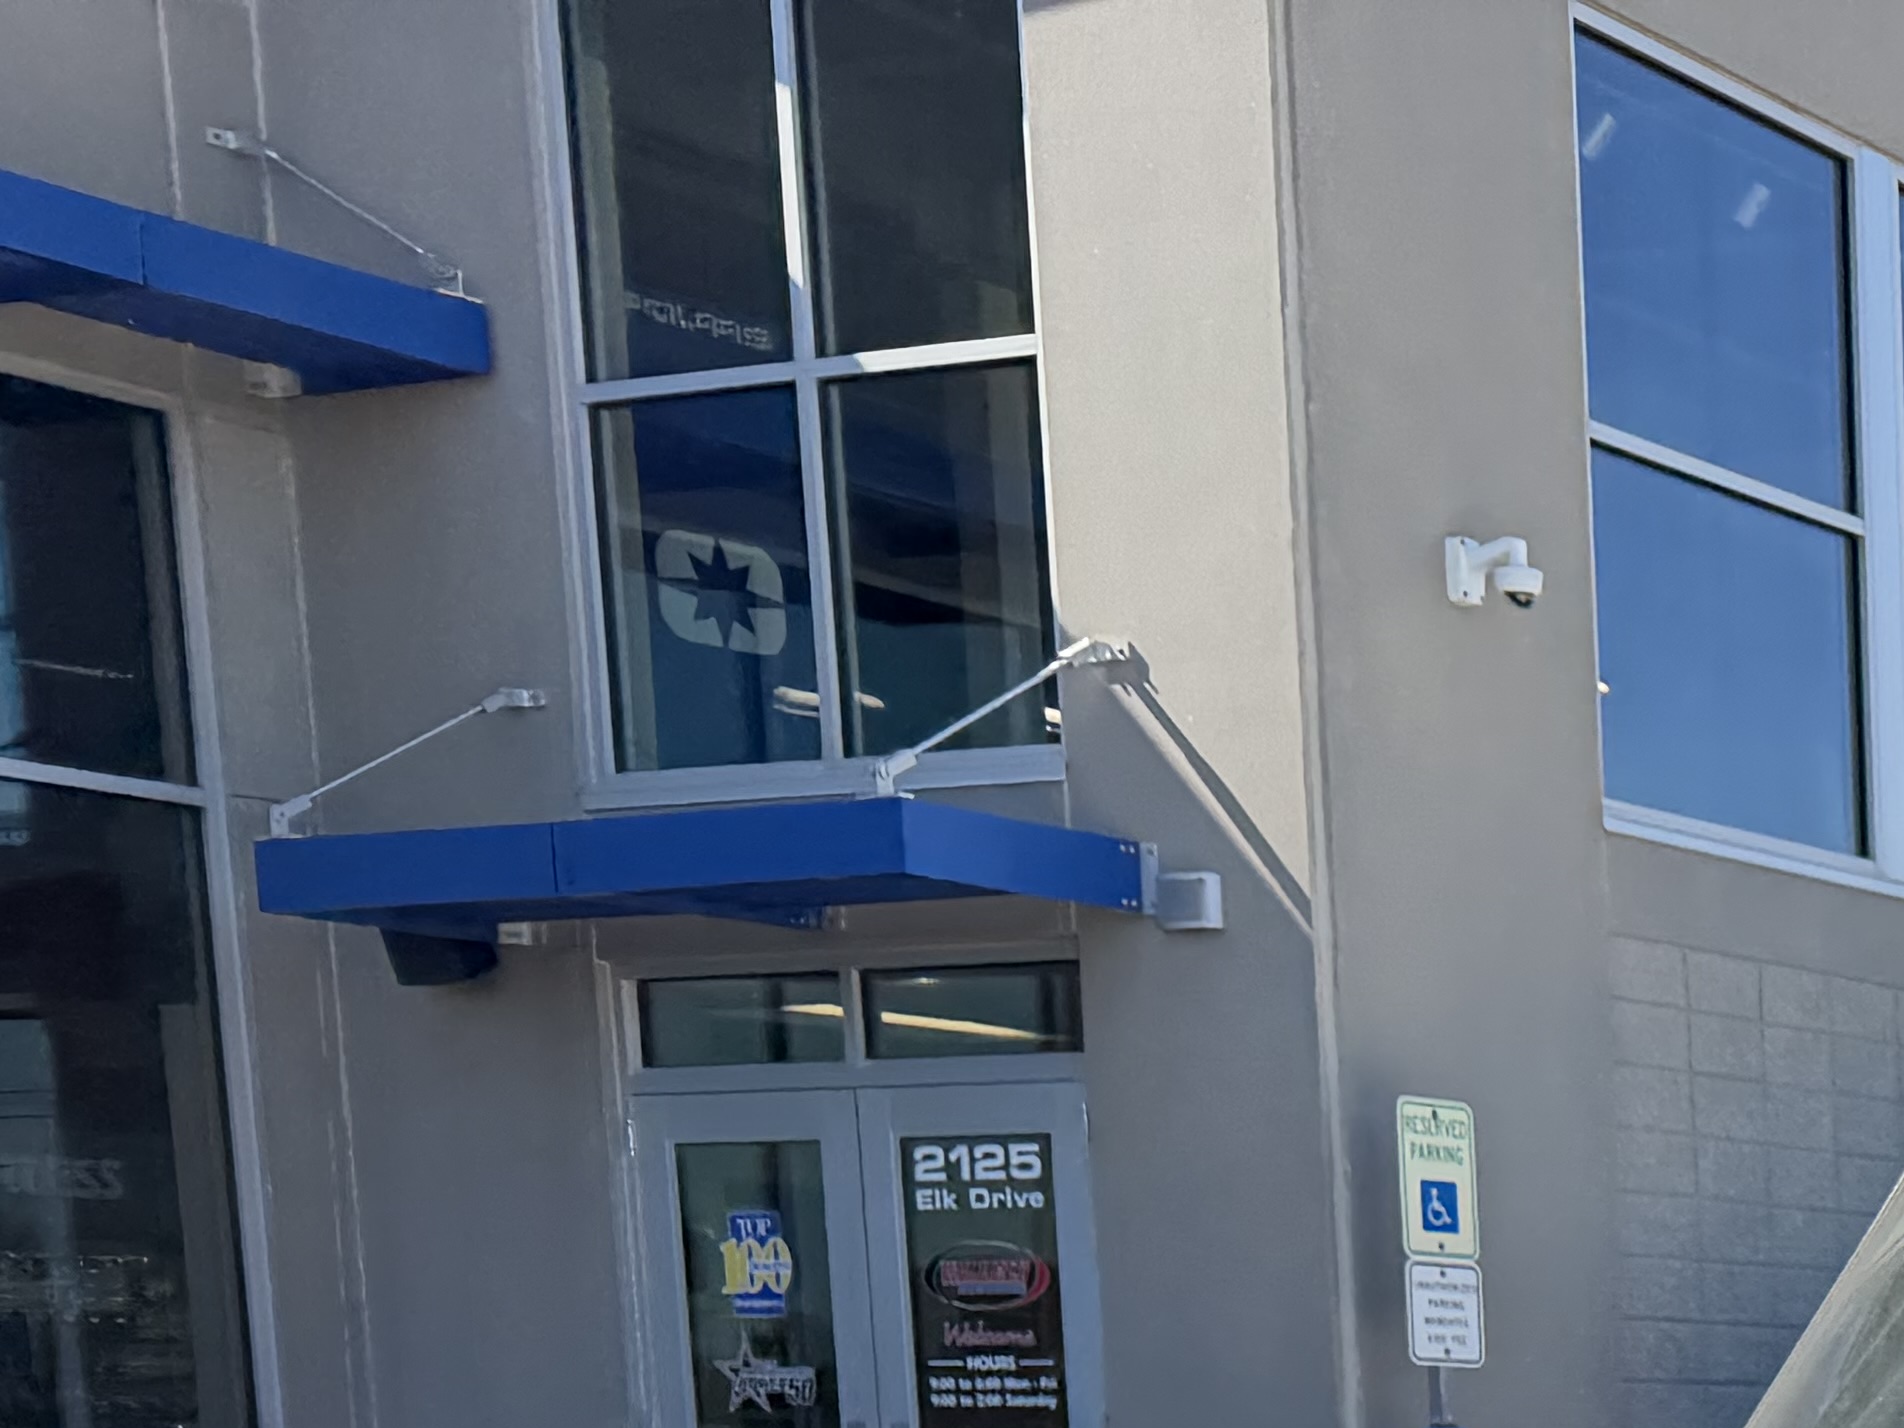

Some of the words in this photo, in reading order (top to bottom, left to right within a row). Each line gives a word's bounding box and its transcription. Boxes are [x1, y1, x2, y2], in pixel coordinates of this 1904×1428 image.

[1404, 1113, 1468, 1140] RESERVED
[913, 1143, 1043, 1182] 2125
[1410, 1141, 1465, 1167] PARKING
[915, 1187, 958, 1211] Elk
[969, 1186, 1045, 1210] Drive
[736, 1218, 772, 1238] TOP
[719, 1236, 793, 1295] 100
[943, 1320, 1038, 1347] Welcome
[966, 1355, 1017, 1371] HOURS
